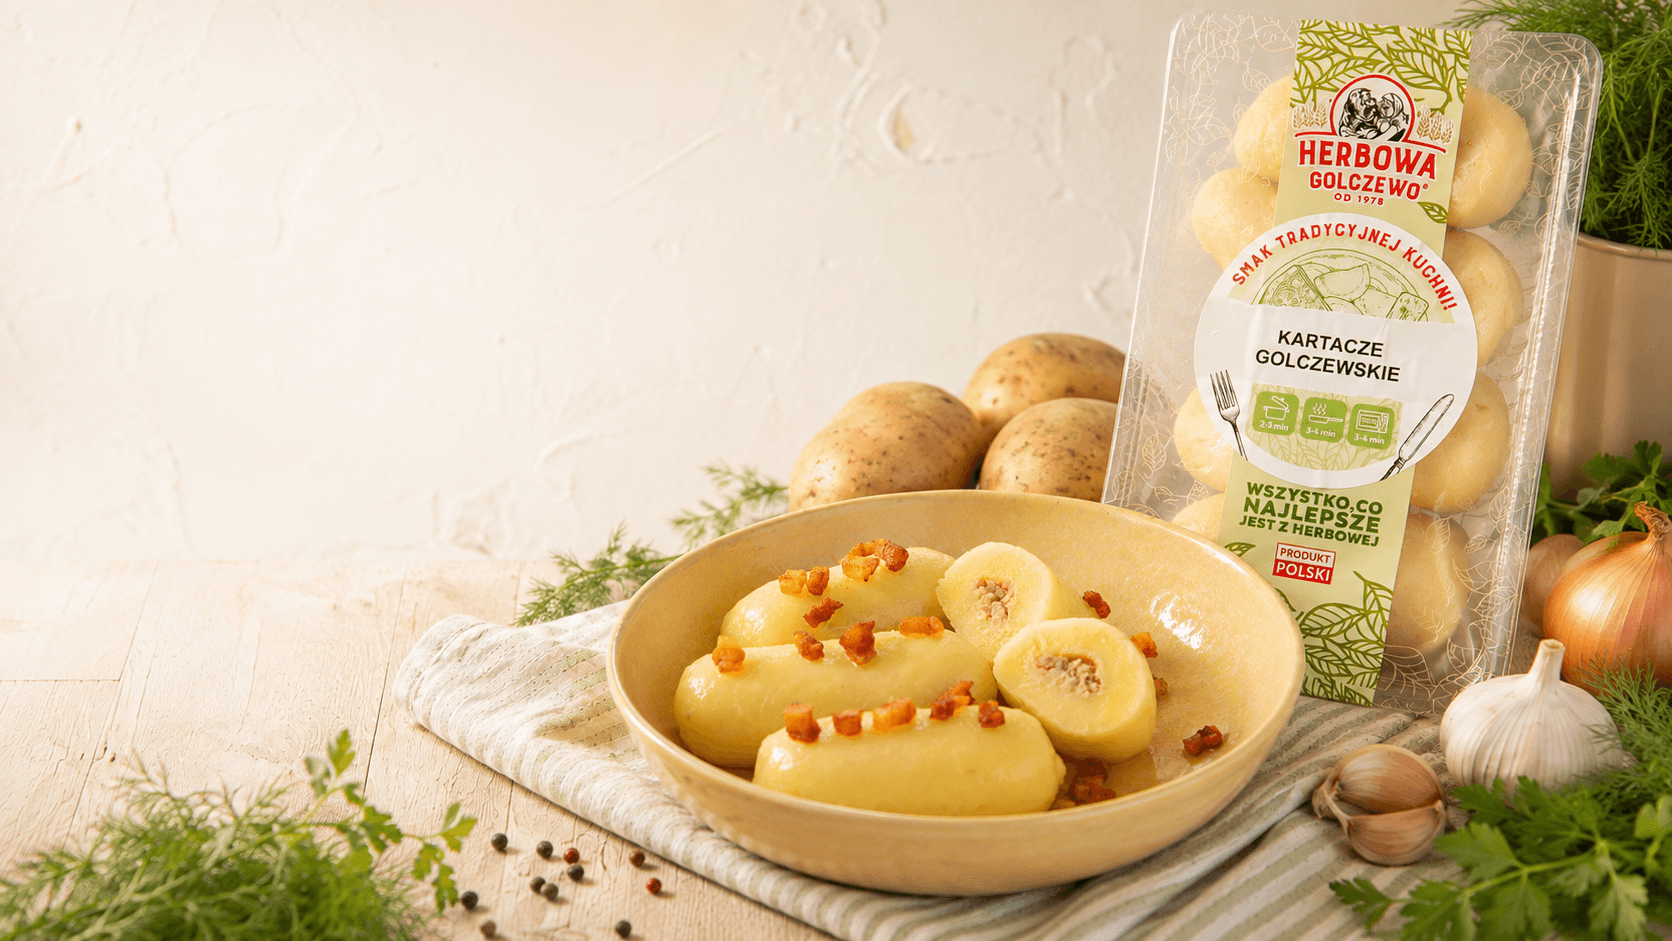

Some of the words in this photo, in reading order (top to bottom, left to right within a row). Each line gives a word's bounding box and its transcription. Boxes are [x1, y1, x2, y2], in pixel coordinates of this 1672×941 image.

[1299, 140, 1436, 180] HERBOWA
[1310, 171, 1421, 200] GOLCZEWO
[1334, 193, 1351, 202] OD
[1358, 194, 1384, 206] 1978
[1232, 244, 1273, 285] SMAK
[1275, 223, 1401, 252] TRADYCYJNEJ
[1402, 246, 1458, 311] KUCHNI!
[1278, 330, 1384, 357] KARTACZE
[1256, 349, 1400, 382] GOLCZEWSKIE
[1273, 422, 1290, 431] min
[1320, 428, 1336, 438] min
[1369, 435, 1386, 445] min
[1243, 497, 1381, 534] NAJLEPSZE
[1239, 515, 1276, 531] JEST
[1278, 521, 1289, 532] Z
[1292, 523, 1380, 547] HERBOWEJ
[1280, 547, 1331, 563] PRODUKT
[1276, 561, 1331, 582] POLSKI
